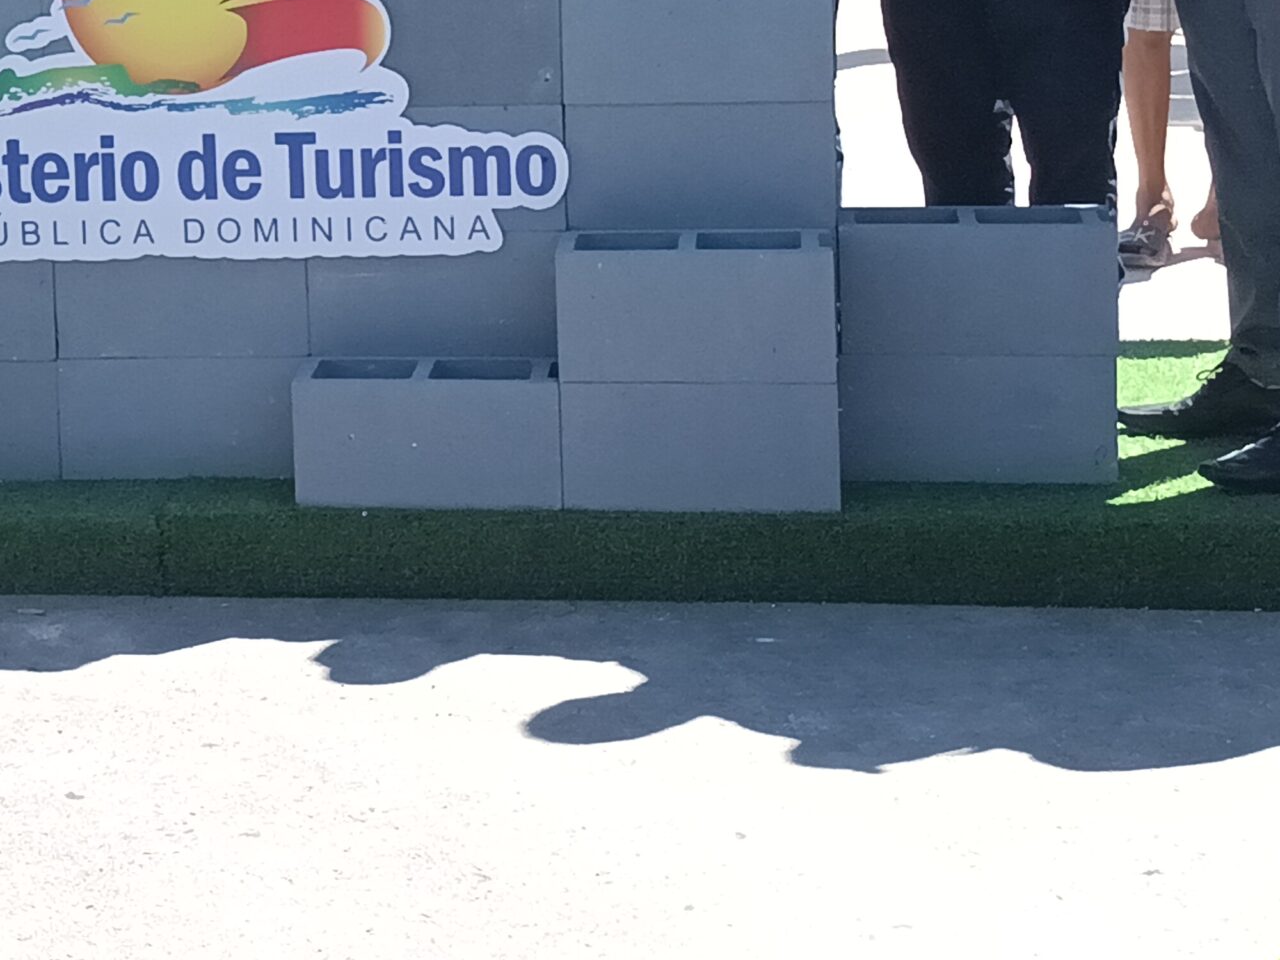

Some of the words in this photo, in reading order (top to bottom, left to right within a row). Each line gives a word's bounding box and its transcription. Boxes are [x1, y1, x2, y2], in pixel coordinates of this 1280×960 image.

[177, 133, 262, 201] de
[274, 130, 557, 199] Turismo
[183, 215, 491, 243] DOMINICANA
